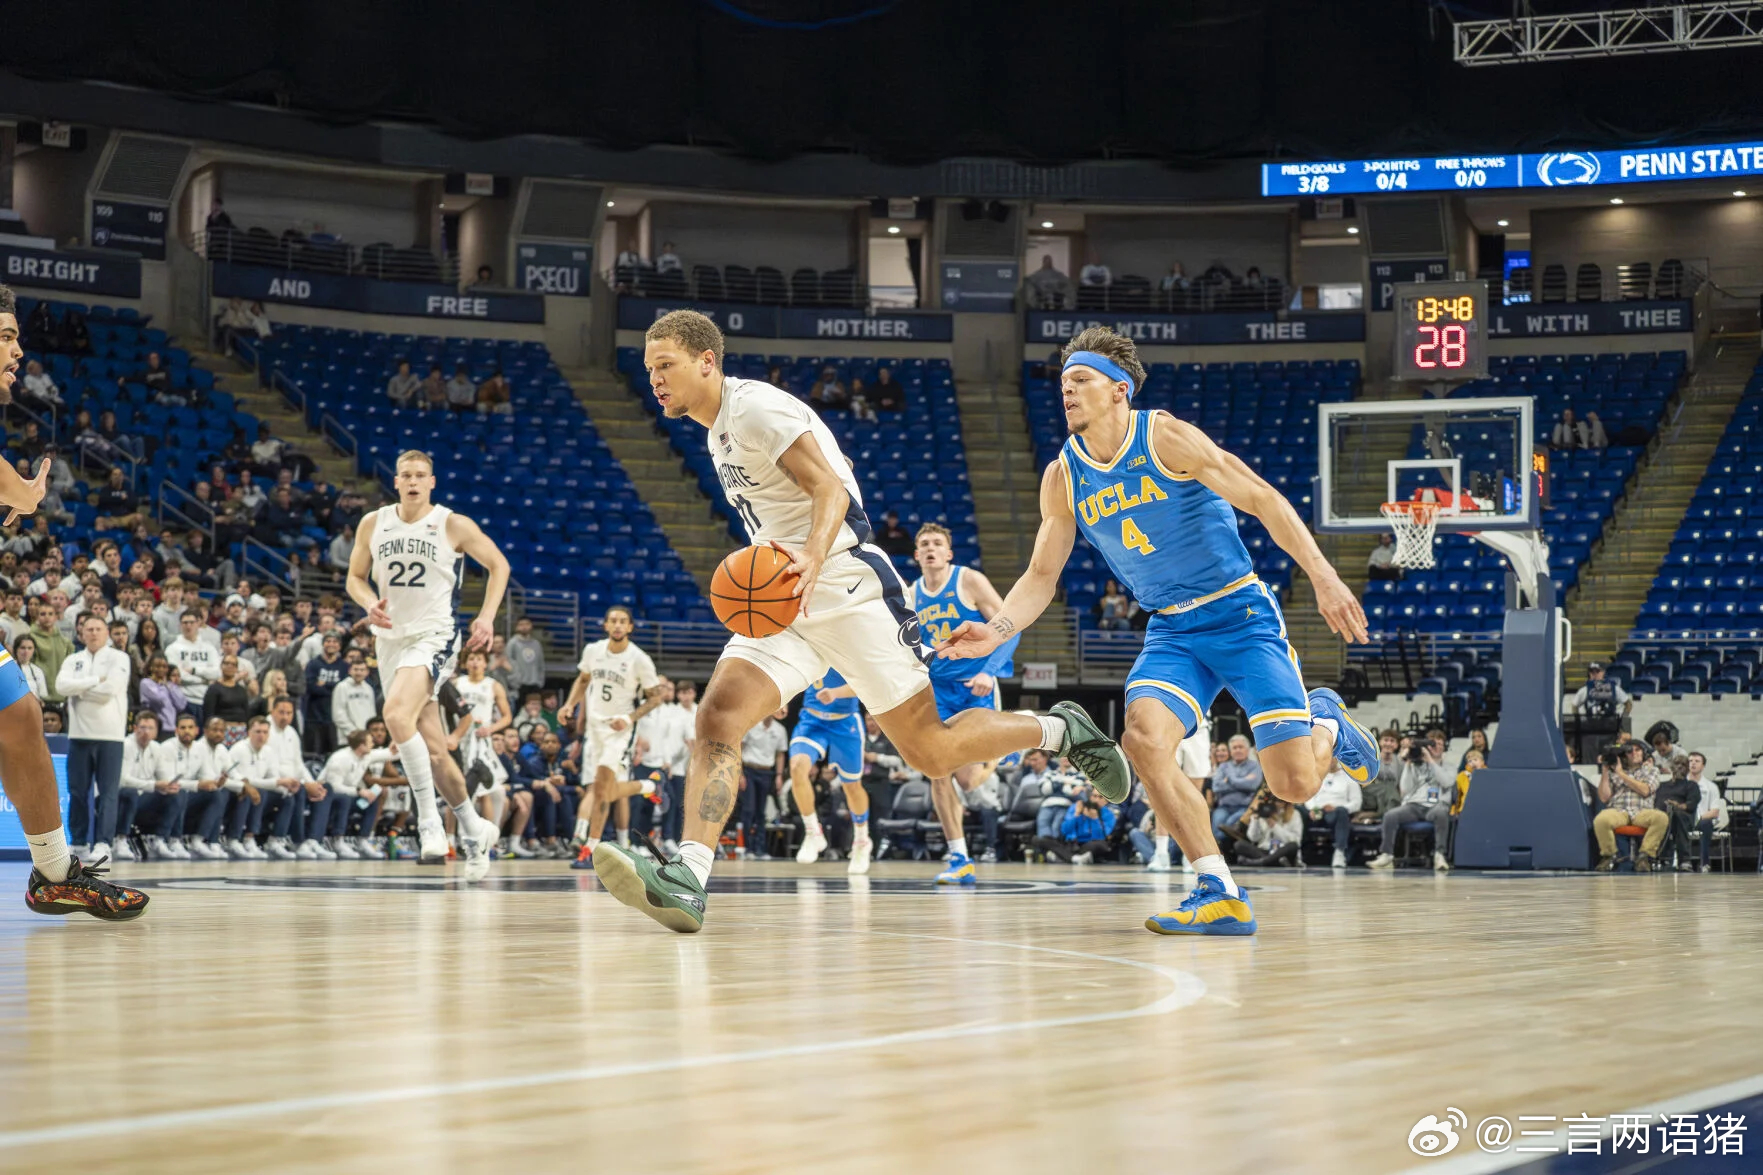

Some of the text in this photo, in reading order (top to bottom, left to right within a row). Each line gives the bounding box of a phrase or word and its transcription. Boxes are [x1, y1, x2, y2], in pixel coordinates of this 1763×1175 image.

[1281, 163, 1346, 175] FIELD GOALS
[1363, 162, 1402, 172] 3-POINT
[1435, 157, 1506, 169] FREE THROWS
[1620, 146, 1763, 178] PENN STATE
[1298, 176, 1330, 193] 3/8
[1376, 173, 1407, 190] 0/4
[1455, 170, 1487, 187] 0/0
[7, 255, 100, 283] BRIGHT
[525, 265, 579, 293] PSECU
[268, 278, 311, 298] AND
[427, 296, 488, 316] FREE
[1417, 296, 1473, 323] 13:48
[728, 313, 744, 331] O
[817, 318, 913, 339] MOTHER,
[1116, 321, 1177, 340] WITH
[1246, 322, 1306, 339] THEE
[1526, 315, 1589, 333] WITH
[1620, 308, 1681, 328] THEE
[1414, 324, 1466, 368] 28
[1077, 475, 1168, 527] UCLA
[1121, 517, 1157, 556] 4
[378, 538, 438, 563] PENN STATE
[387, 560, 427, 588] 22
[917, 602, 961, 626] UCLA
[926, 621, 953, 647] 34
[180, 651, 209, 662] PSU
[1024, 668, 1054, 681] EXIT
[601, 684, 613, 703] 5
